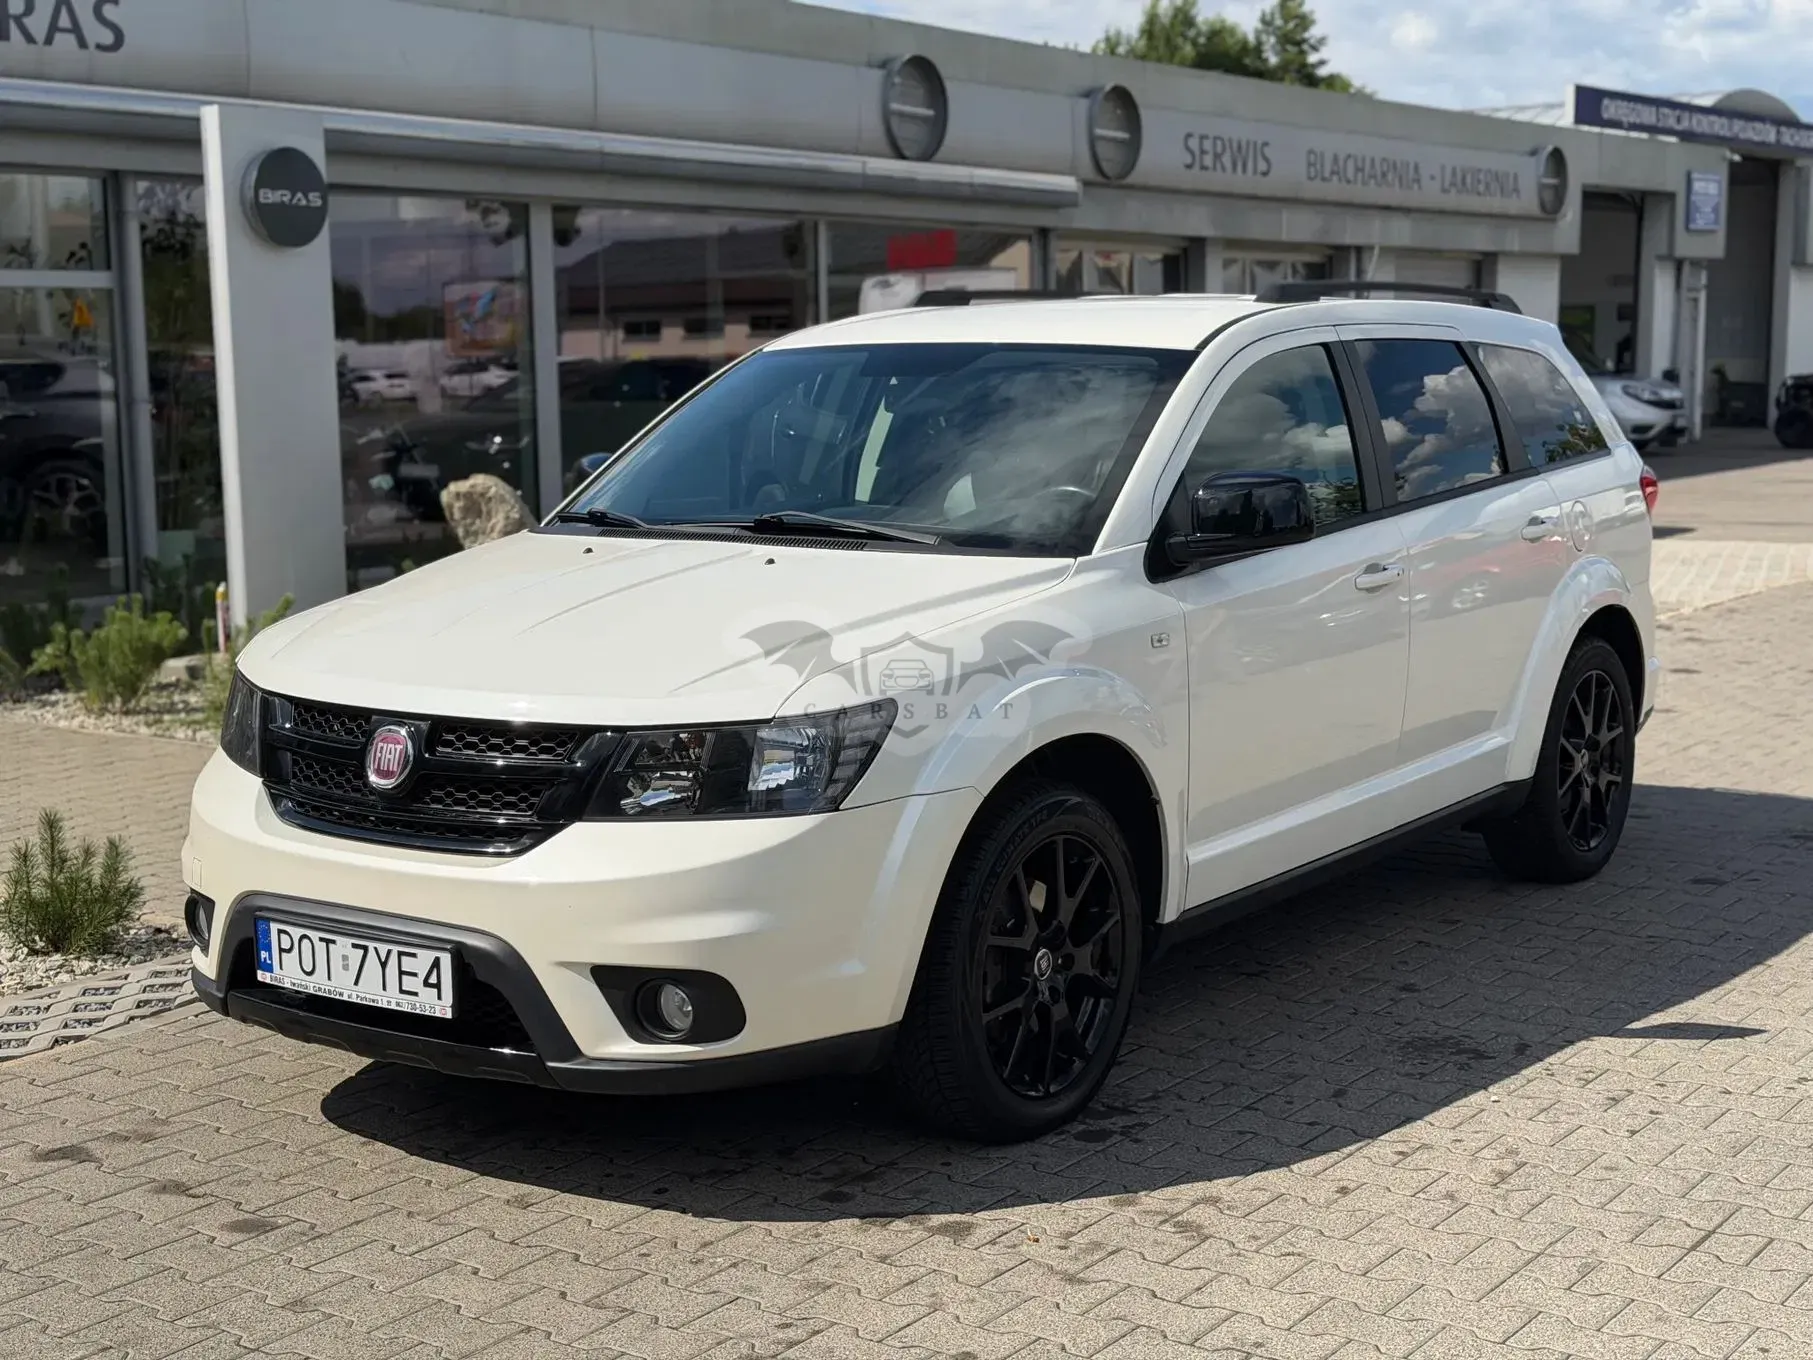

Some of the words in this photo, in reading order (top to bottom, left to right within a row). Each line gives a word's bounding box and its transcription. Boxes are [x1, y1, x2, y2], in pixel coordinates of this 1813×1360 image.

[1183, 131, 1272, 178] SERWIS
[1306, 148, 1422, 191] BLACHARNIA
[1440, 163, 1521, 199] LAKIERNIA
[259, 188, 322, 207] BIRAS
[374, 742, 403, 771] FIAT
[261, 950, 271, 964] PL
[277, 928, 337, 981] POT
[351, 943, 442, 1001] 7YE4
[269, 974, 285, 985] BIRAS
[312, 985, 344, 998] GRABÓW
[355, 993, 379, 1005] Parkowa
